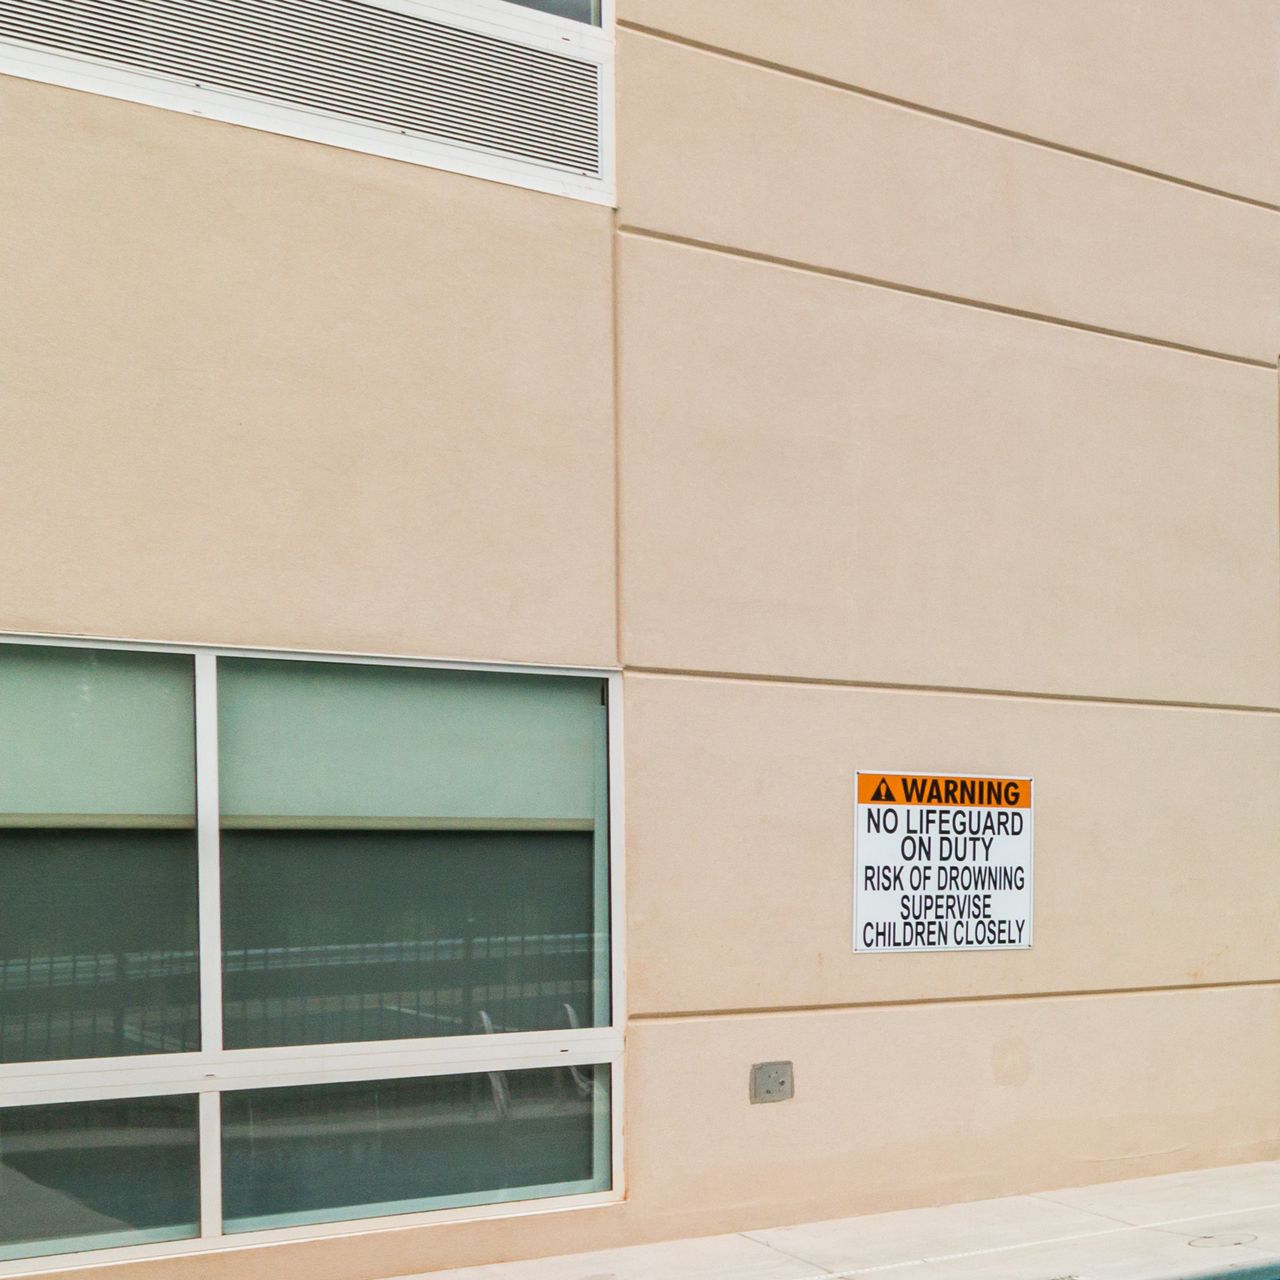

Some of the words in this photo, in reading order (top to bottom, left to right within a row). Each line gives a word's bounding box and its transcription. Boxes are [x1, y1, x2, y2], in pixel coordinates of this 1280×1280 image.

[901, 778, 1020, 806] WARNING
[867, 808, 898, 834] NO
[906, 809, 1023, 836] LIFEGUARD
[901, 836, 932, 861] ON
[939, 837, 994, 862] DUTY
[864, 865, 904, 891] RISK
[910, 866, 932, 891] OF
[937, 866, 1025, 891] DROWNING
[900, 894, 992, 920] SUPERVISE
[863, 921, 948, 948] CHILDREN
[953, 919, 1025, 945] CLOSELY
